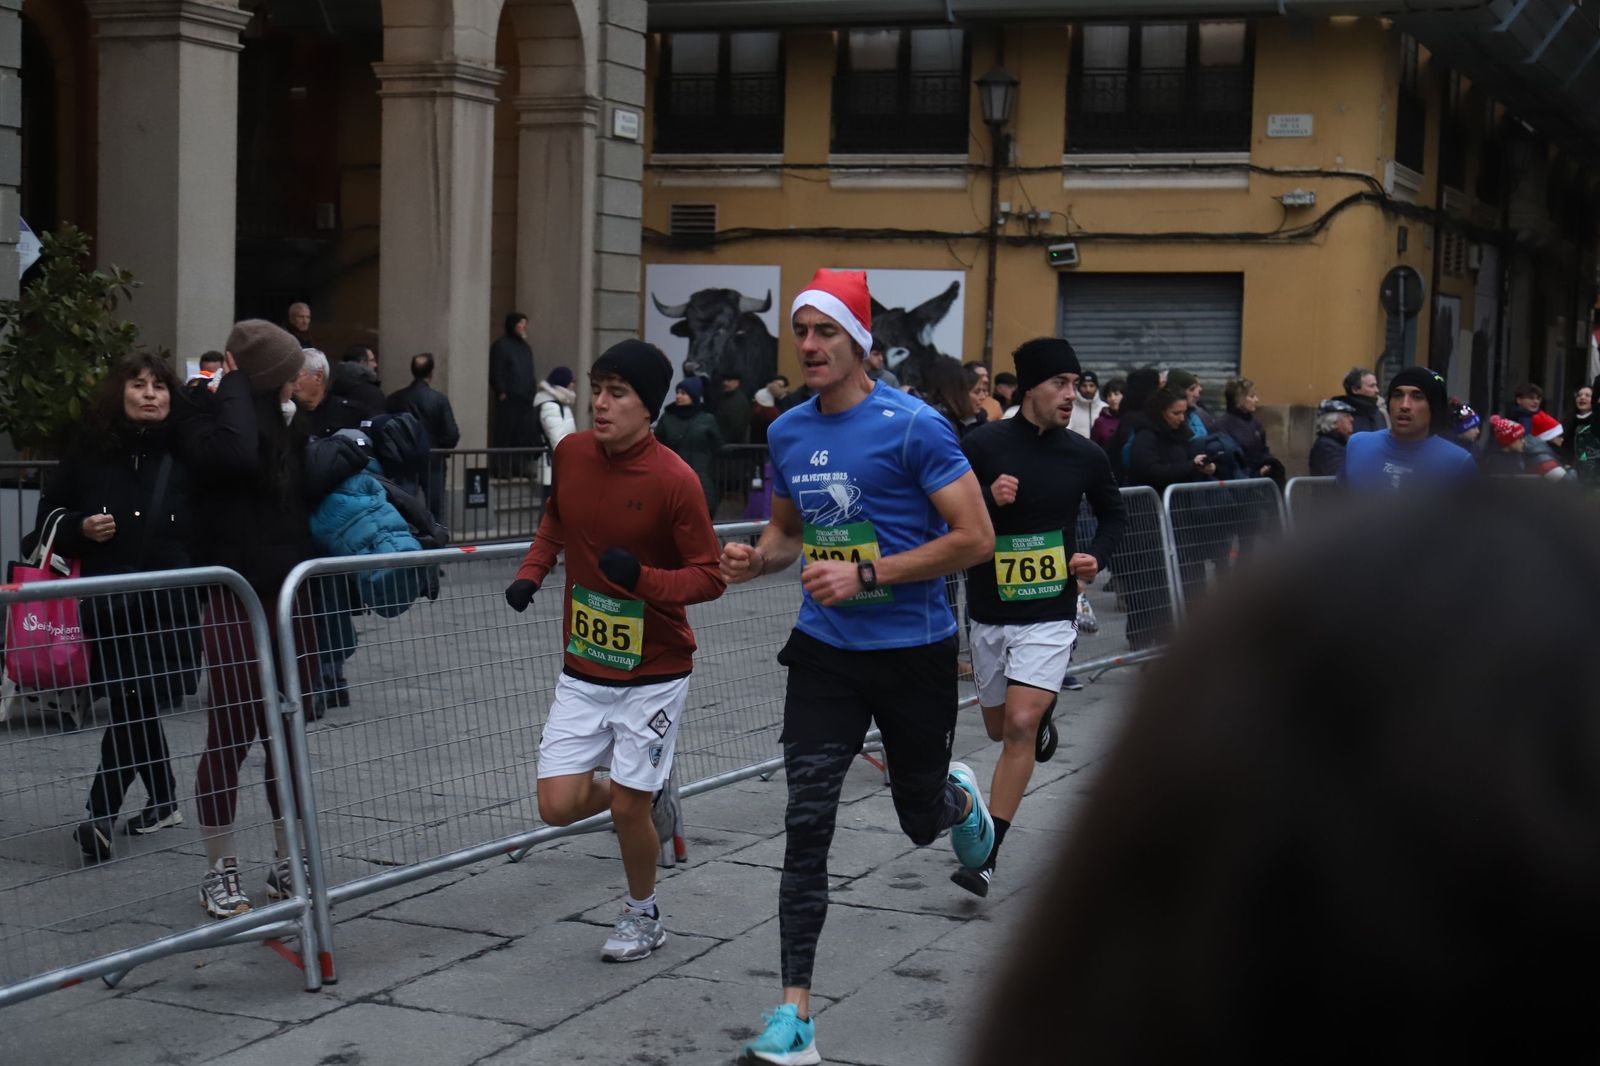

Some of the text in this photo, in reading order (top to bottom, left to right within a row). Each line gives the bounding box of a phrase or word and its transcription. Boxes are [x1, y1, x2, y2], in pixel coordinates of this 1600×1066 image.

[810, 450, 829, 466] 46
[1000, 554, 1056, 584] 768
[575, 610, 630, 650] 685
